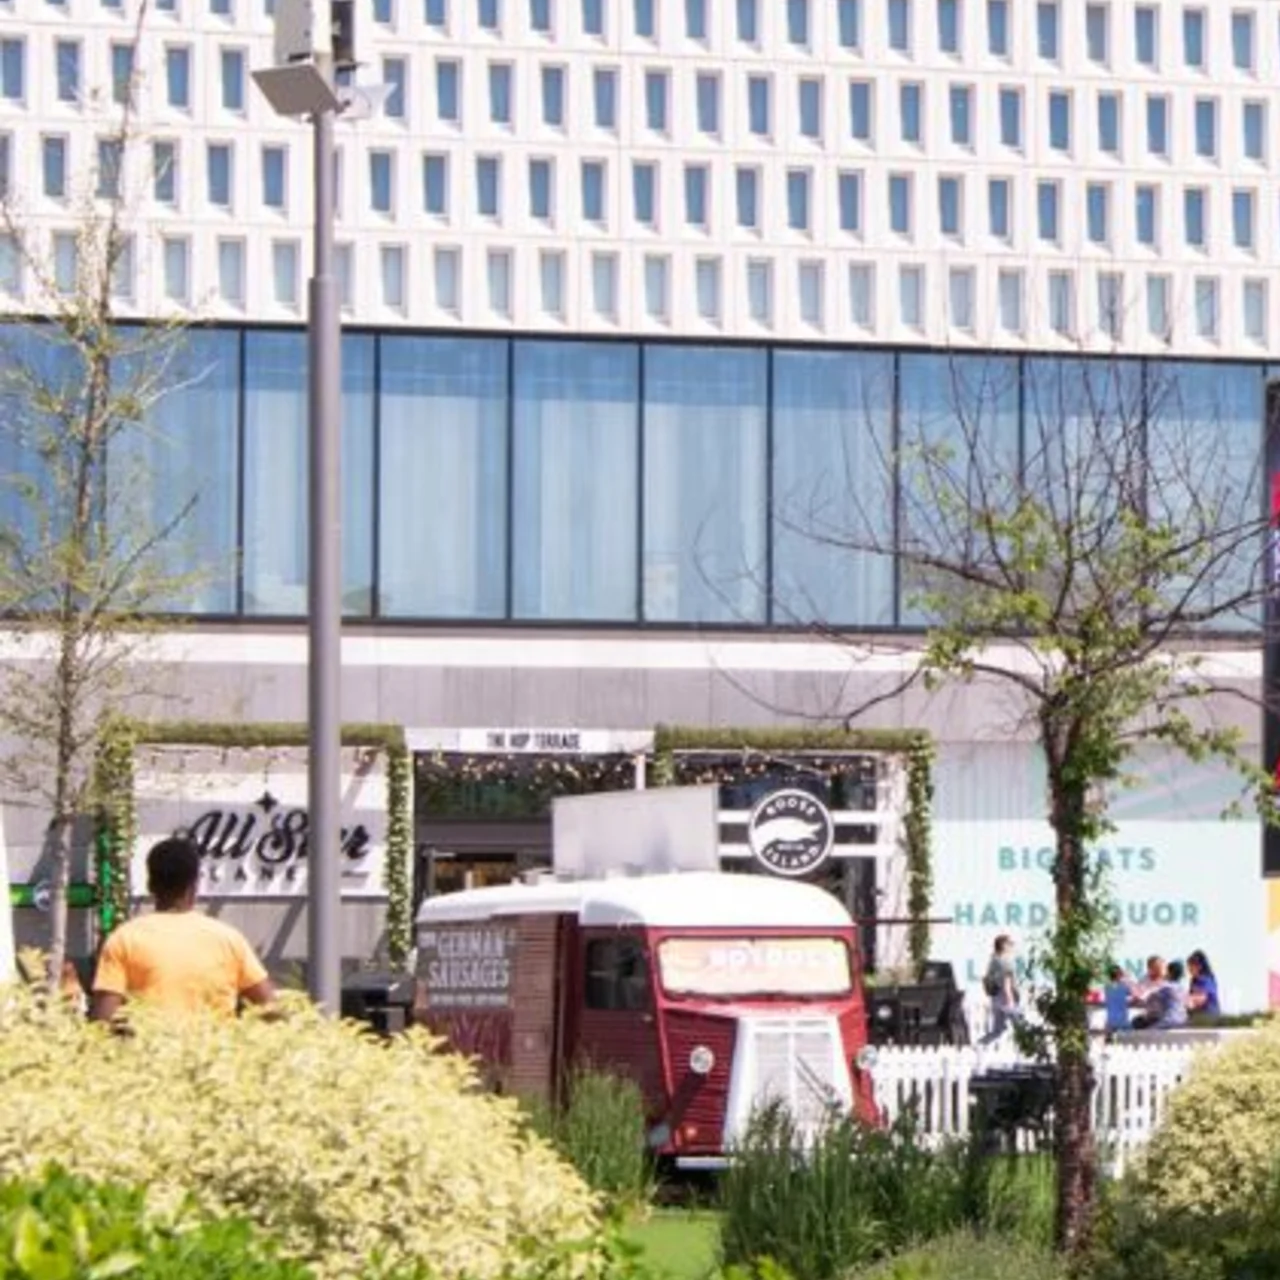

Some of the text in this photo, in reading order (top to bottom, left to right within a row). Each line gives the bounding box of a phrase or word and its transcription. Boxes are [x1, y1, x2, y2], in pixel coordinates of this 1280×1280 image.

[256, 809, 369, 863] Sr
[766, 845, 821, 867] ISLAND
[1097, 847, 1156, 870] ATS
[208, 866, 297, 883] LANE
[954, 902, 1048, 926] HARD
